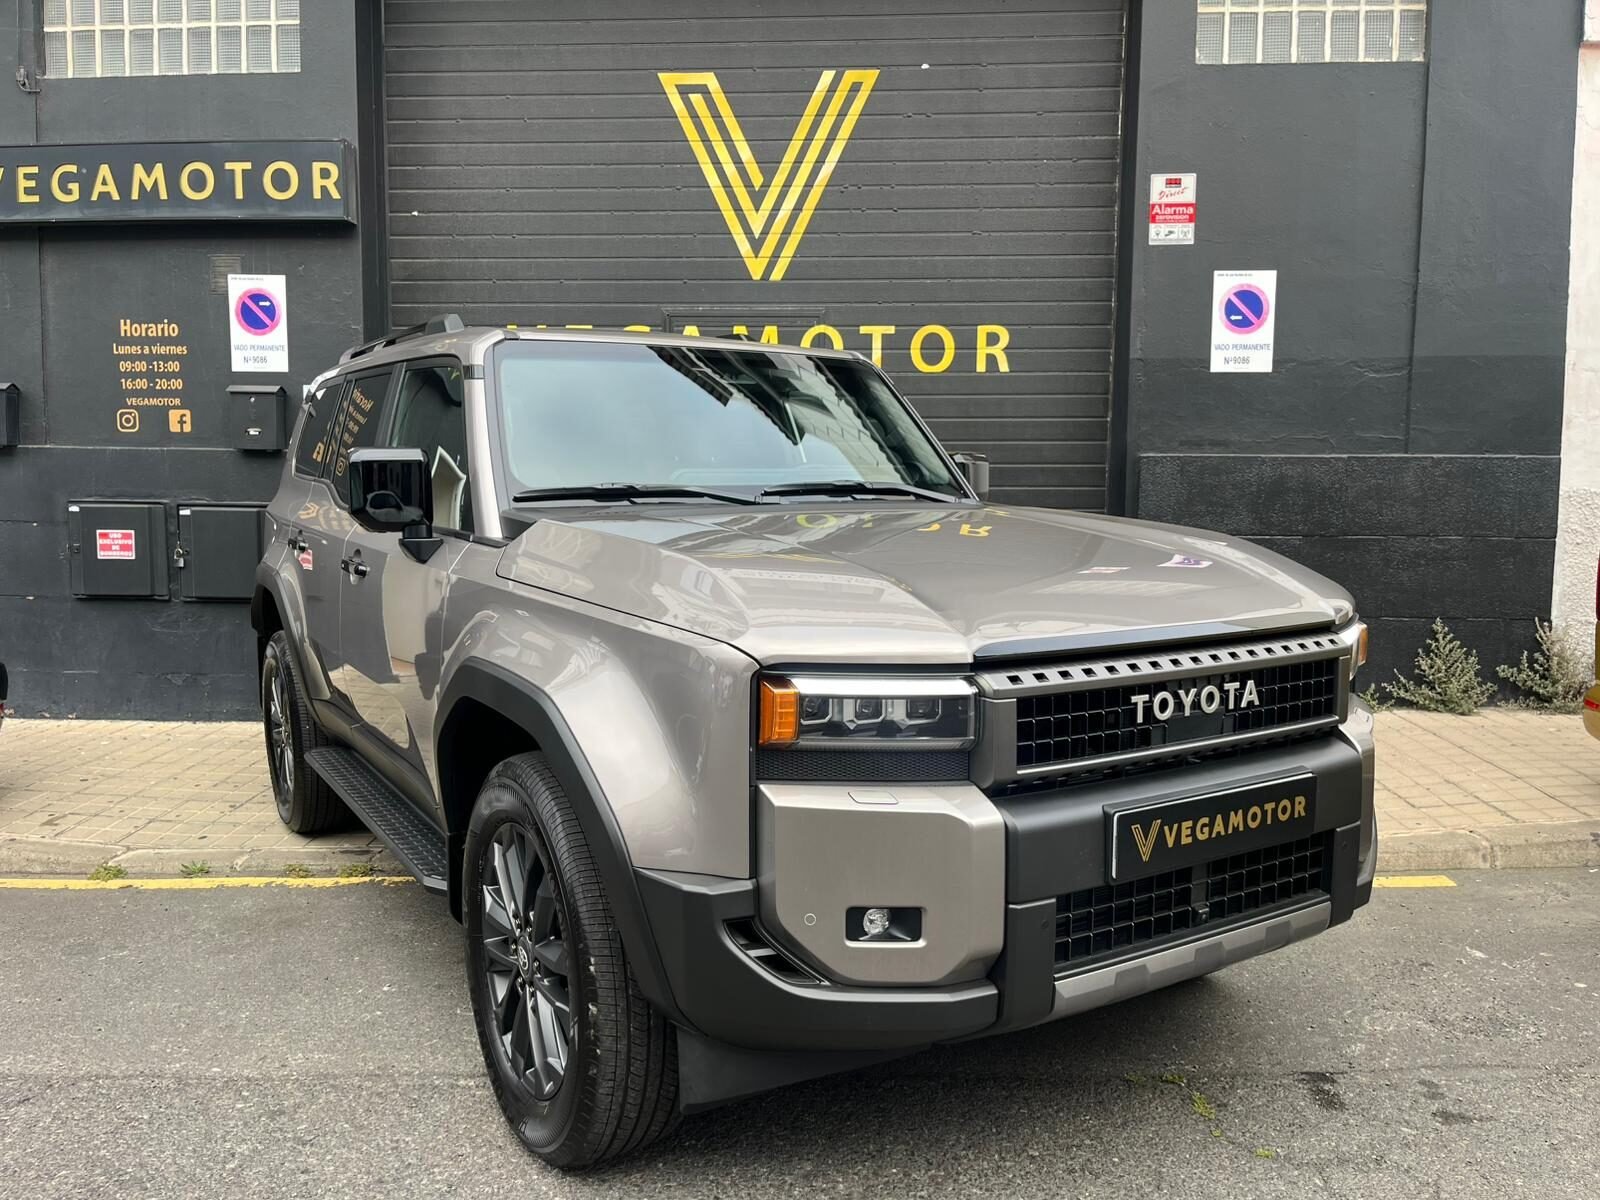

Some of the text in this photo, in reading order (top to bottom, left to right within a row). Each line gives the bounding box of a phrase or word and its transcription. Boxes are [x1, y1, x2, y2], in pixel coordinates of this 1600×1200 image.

[0, 160, 342, 203] EGAMOTOR
[1151, 203, 1194, 215] Alarma
[120, 319, 179, 337] Horario
[113, 342, 188, 355] Lunes a viernes
[234, 344, 286, 352] VADO PERMANENTE
[1214, 343, 1271, 351] VADO PERMANENTE
[119, 360, 147, 373] 09:00
[120, 378, 148, 390] 16:00
[155, 378, 183, 390] 20:00
[126, 397, 181, 406] VEGAMOTOR
[1131, 679, 1260, 724] TOYOTA
[1164, 795, 1307, 848] VEGAMOTOR
